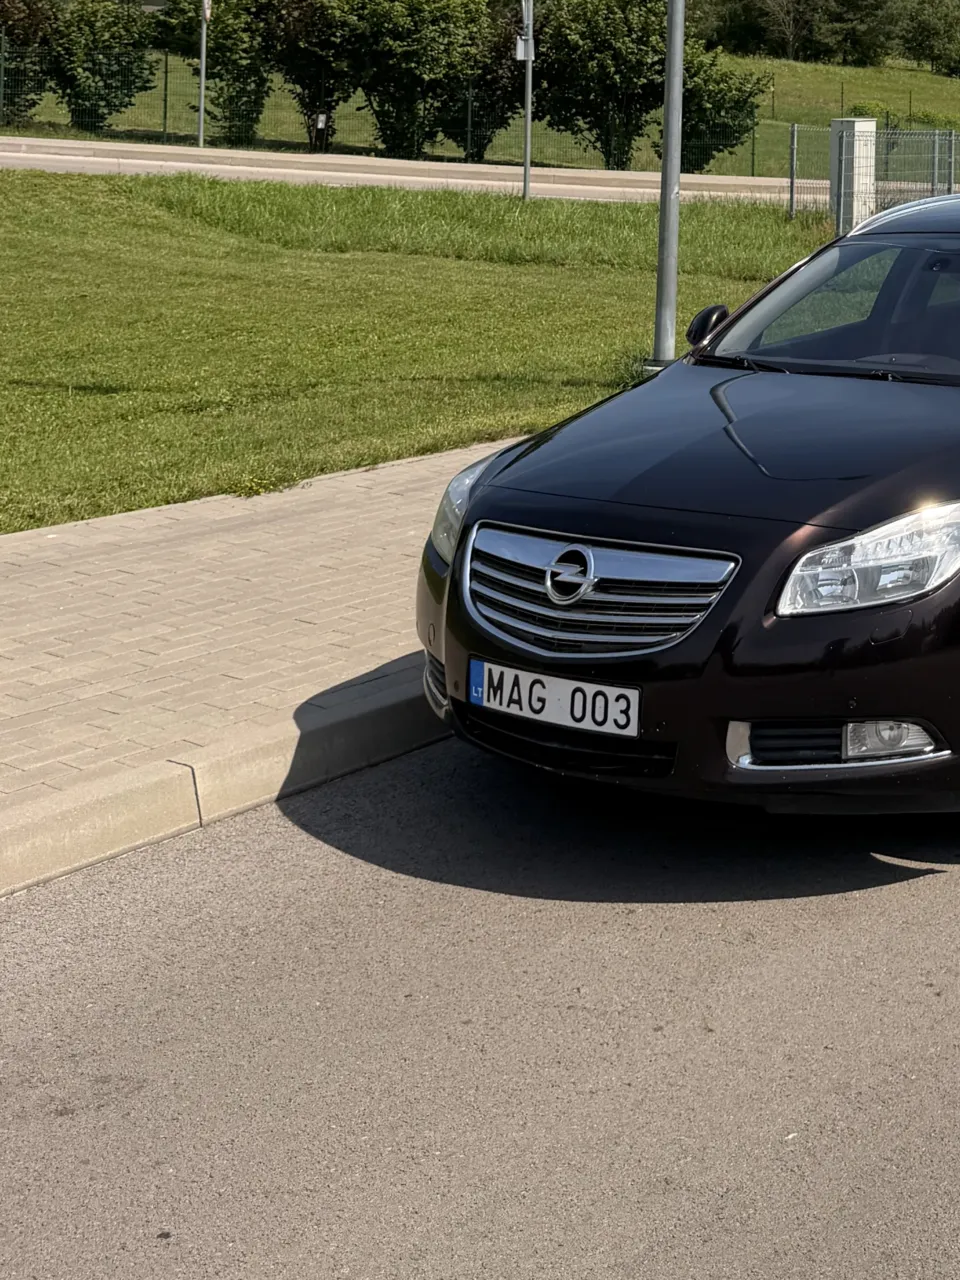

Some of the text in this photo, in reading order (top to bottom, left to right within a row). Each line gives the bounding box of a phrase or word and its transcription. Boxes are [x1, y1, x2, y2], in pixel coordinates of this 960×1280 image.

[472, 686, 483, 698] LT
[486, 667, 631, 730] MAG 003
